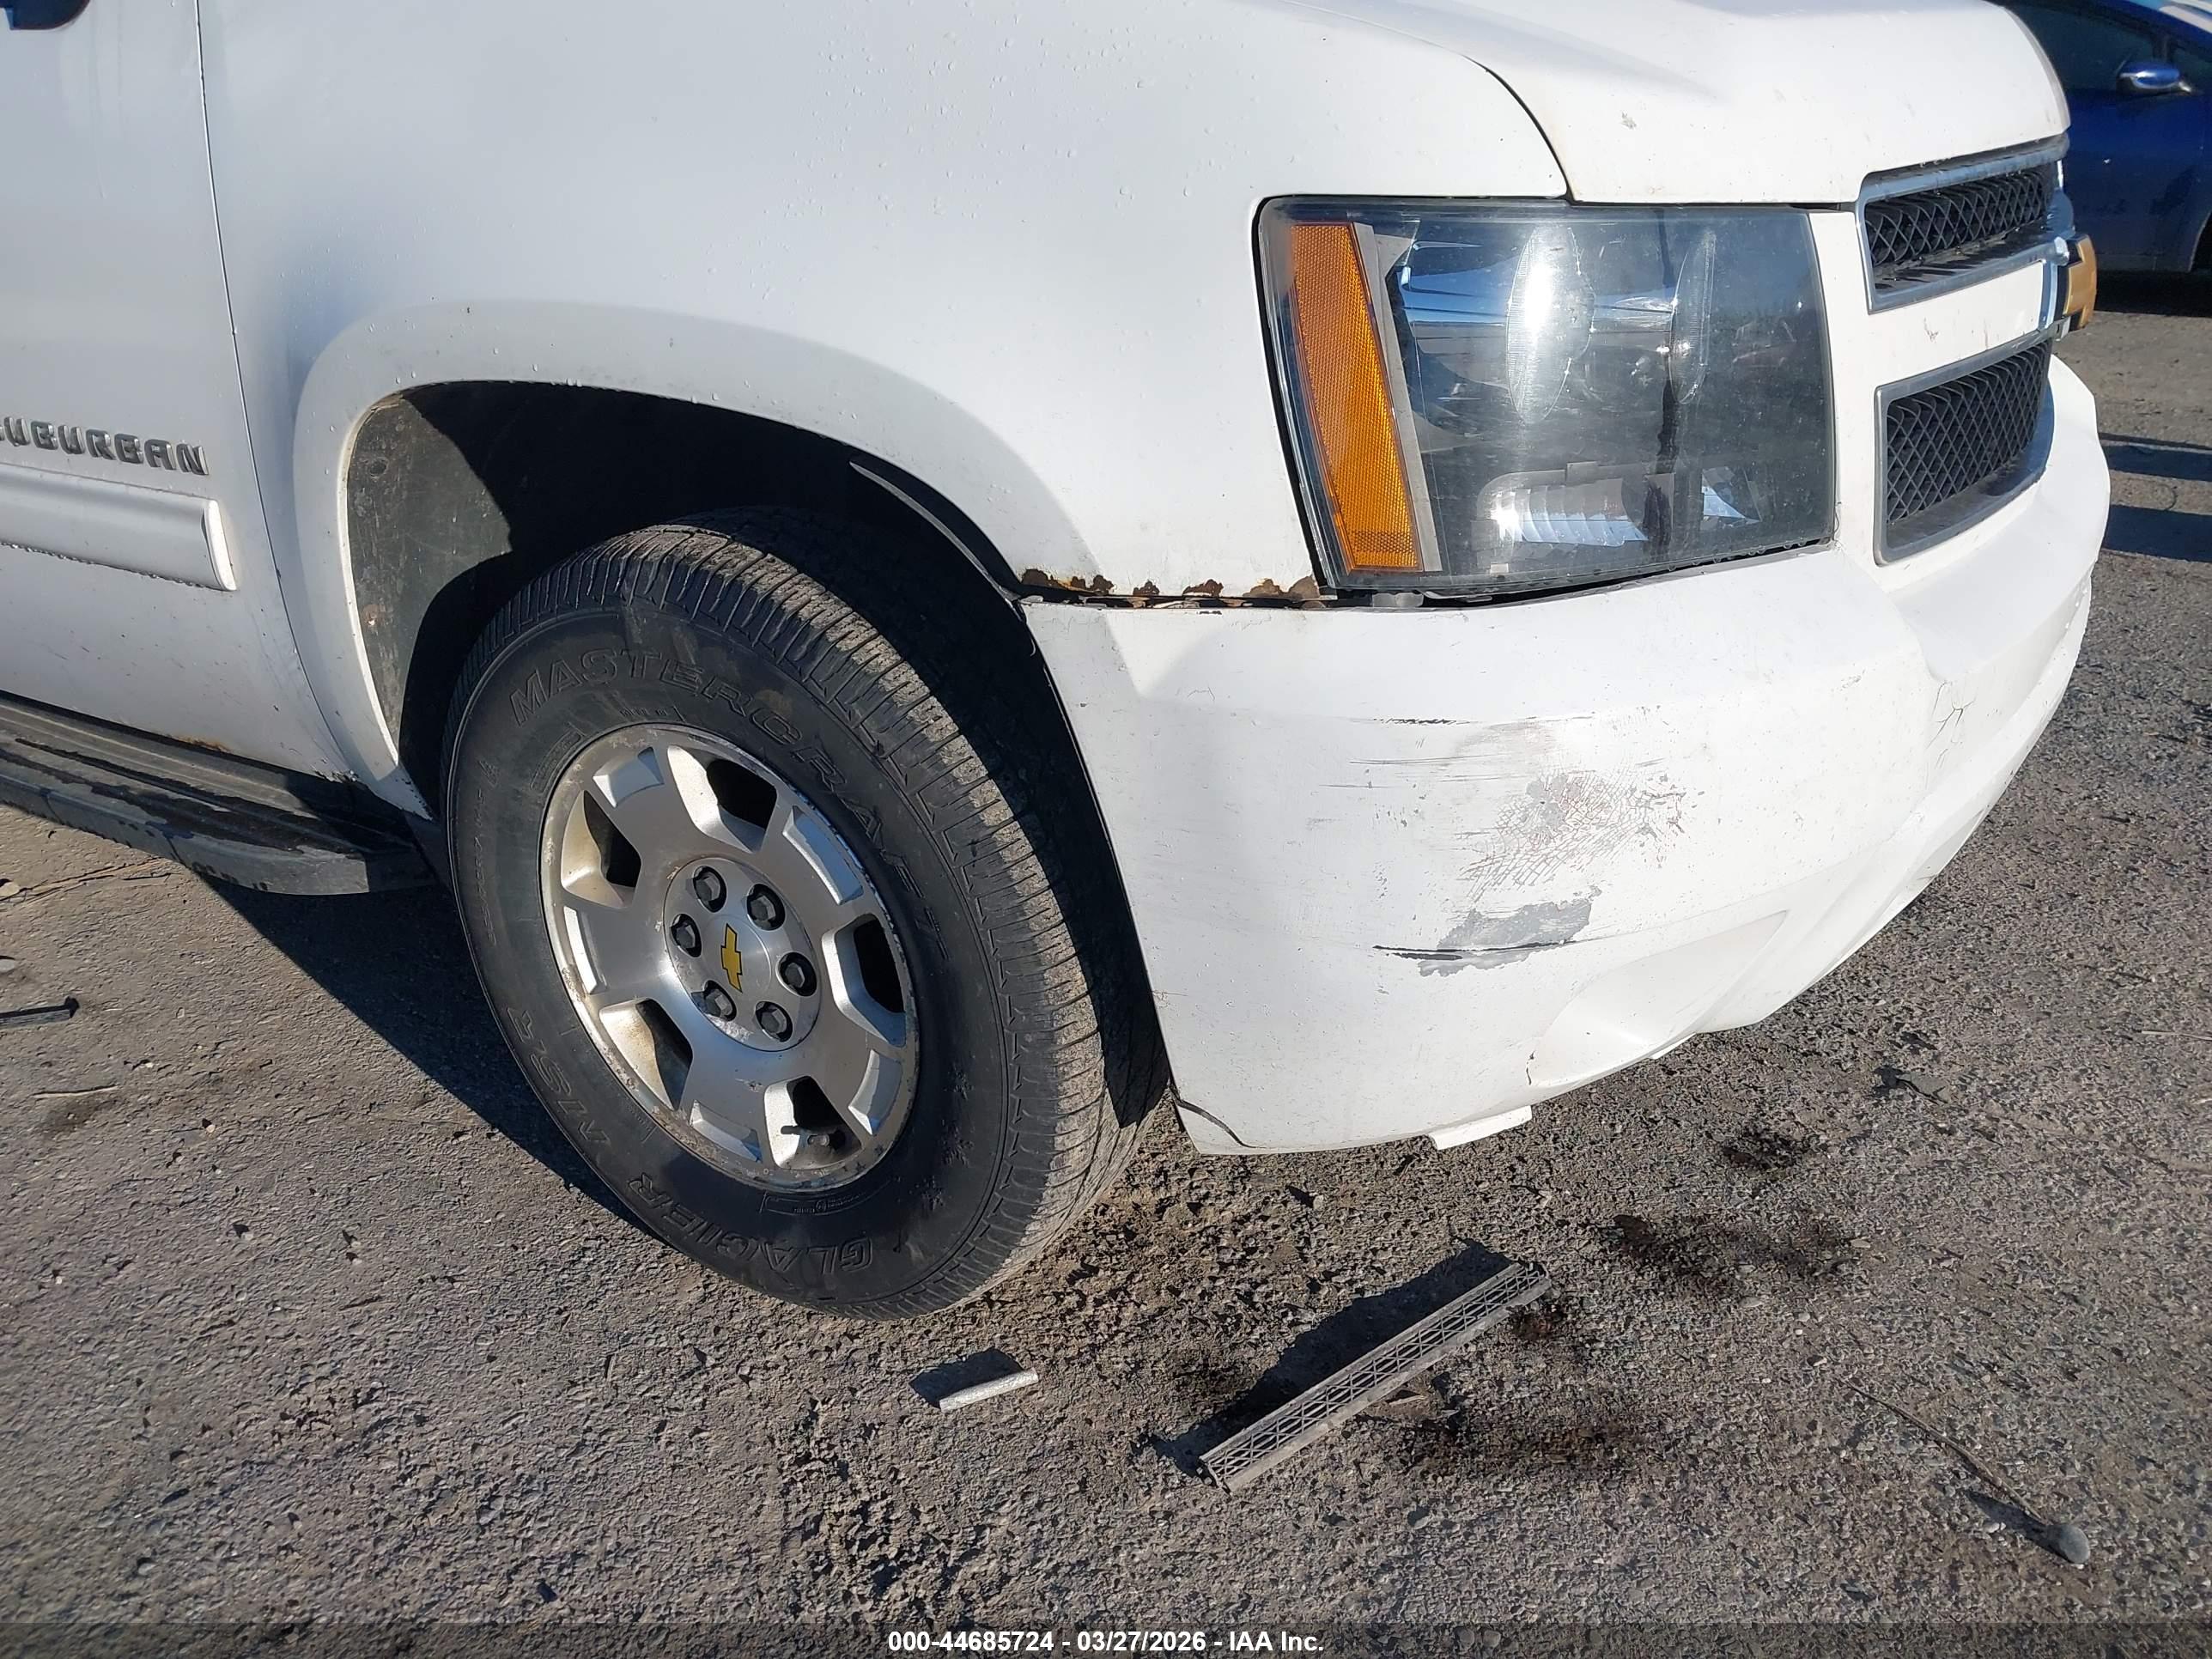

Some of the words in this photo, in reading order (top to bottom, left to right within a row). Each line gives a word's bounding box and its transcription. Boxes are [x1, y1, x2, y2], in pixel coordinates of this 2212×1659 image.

[0, 416, 209, 476] UBURBAN
[510, 647, 951, 960] MASTERCRAFT
[627, 1172, 874, 1275] GLACIER
